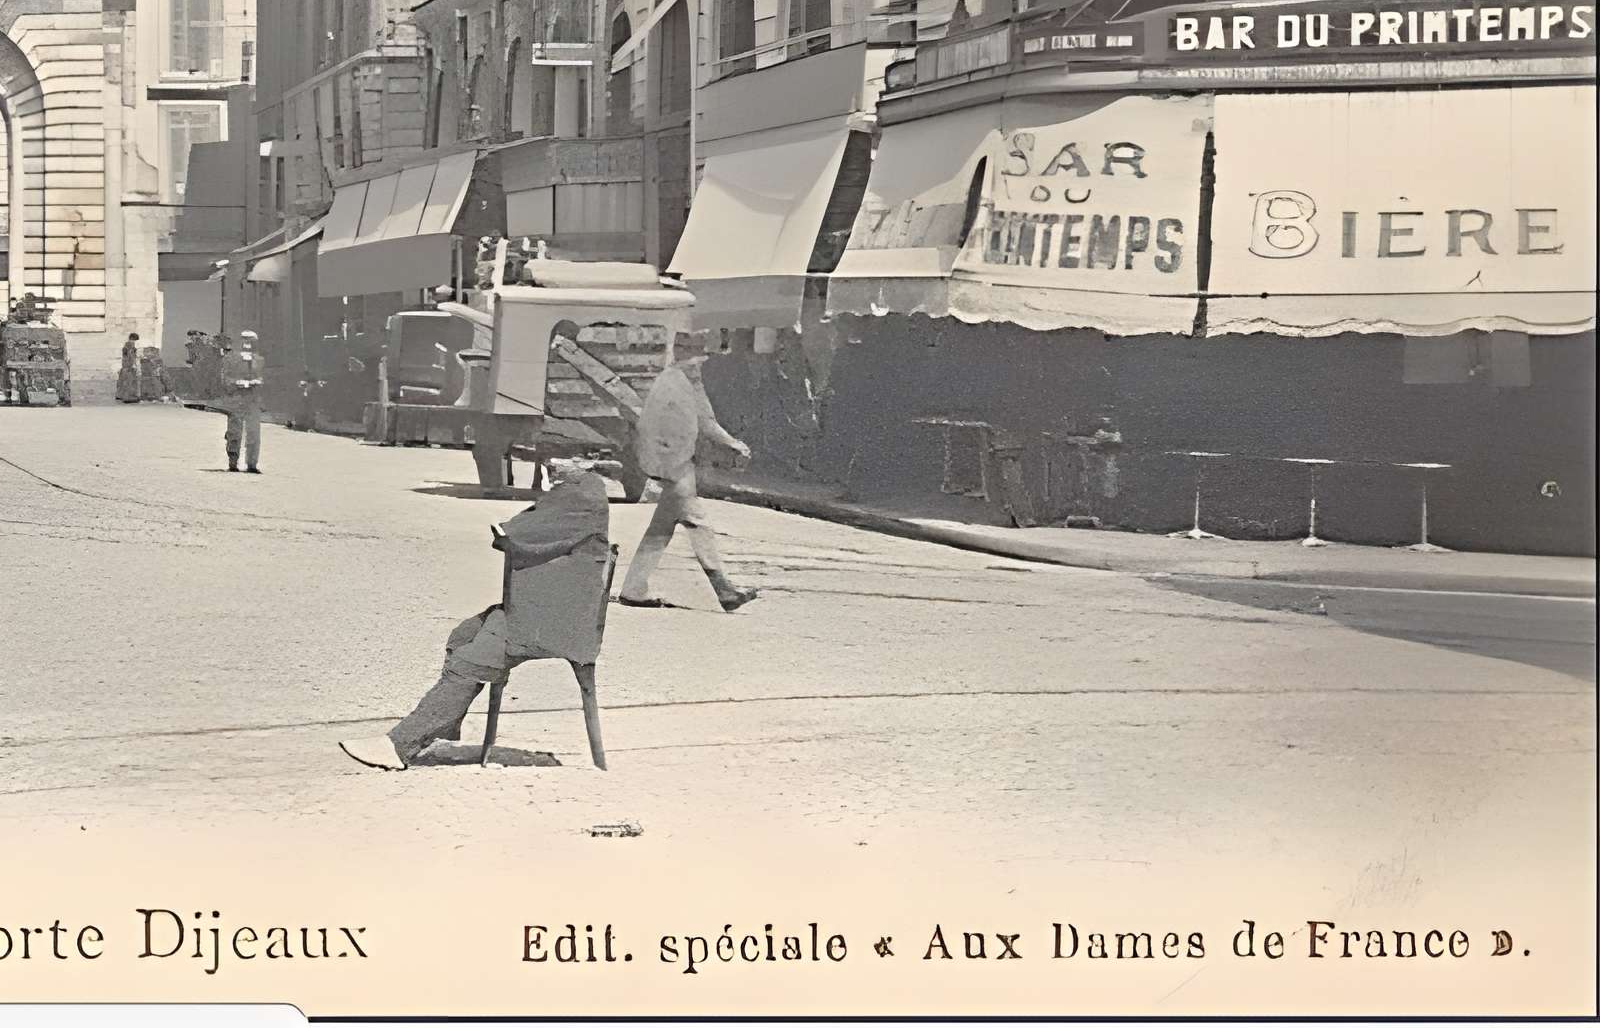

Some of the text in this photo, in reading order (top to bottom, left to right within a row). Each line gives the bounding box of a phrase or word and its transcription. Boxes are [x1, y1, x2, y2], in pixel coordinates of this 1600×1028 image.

[1176, 5, 1592, 51] BAR DU PRINTEMPS
